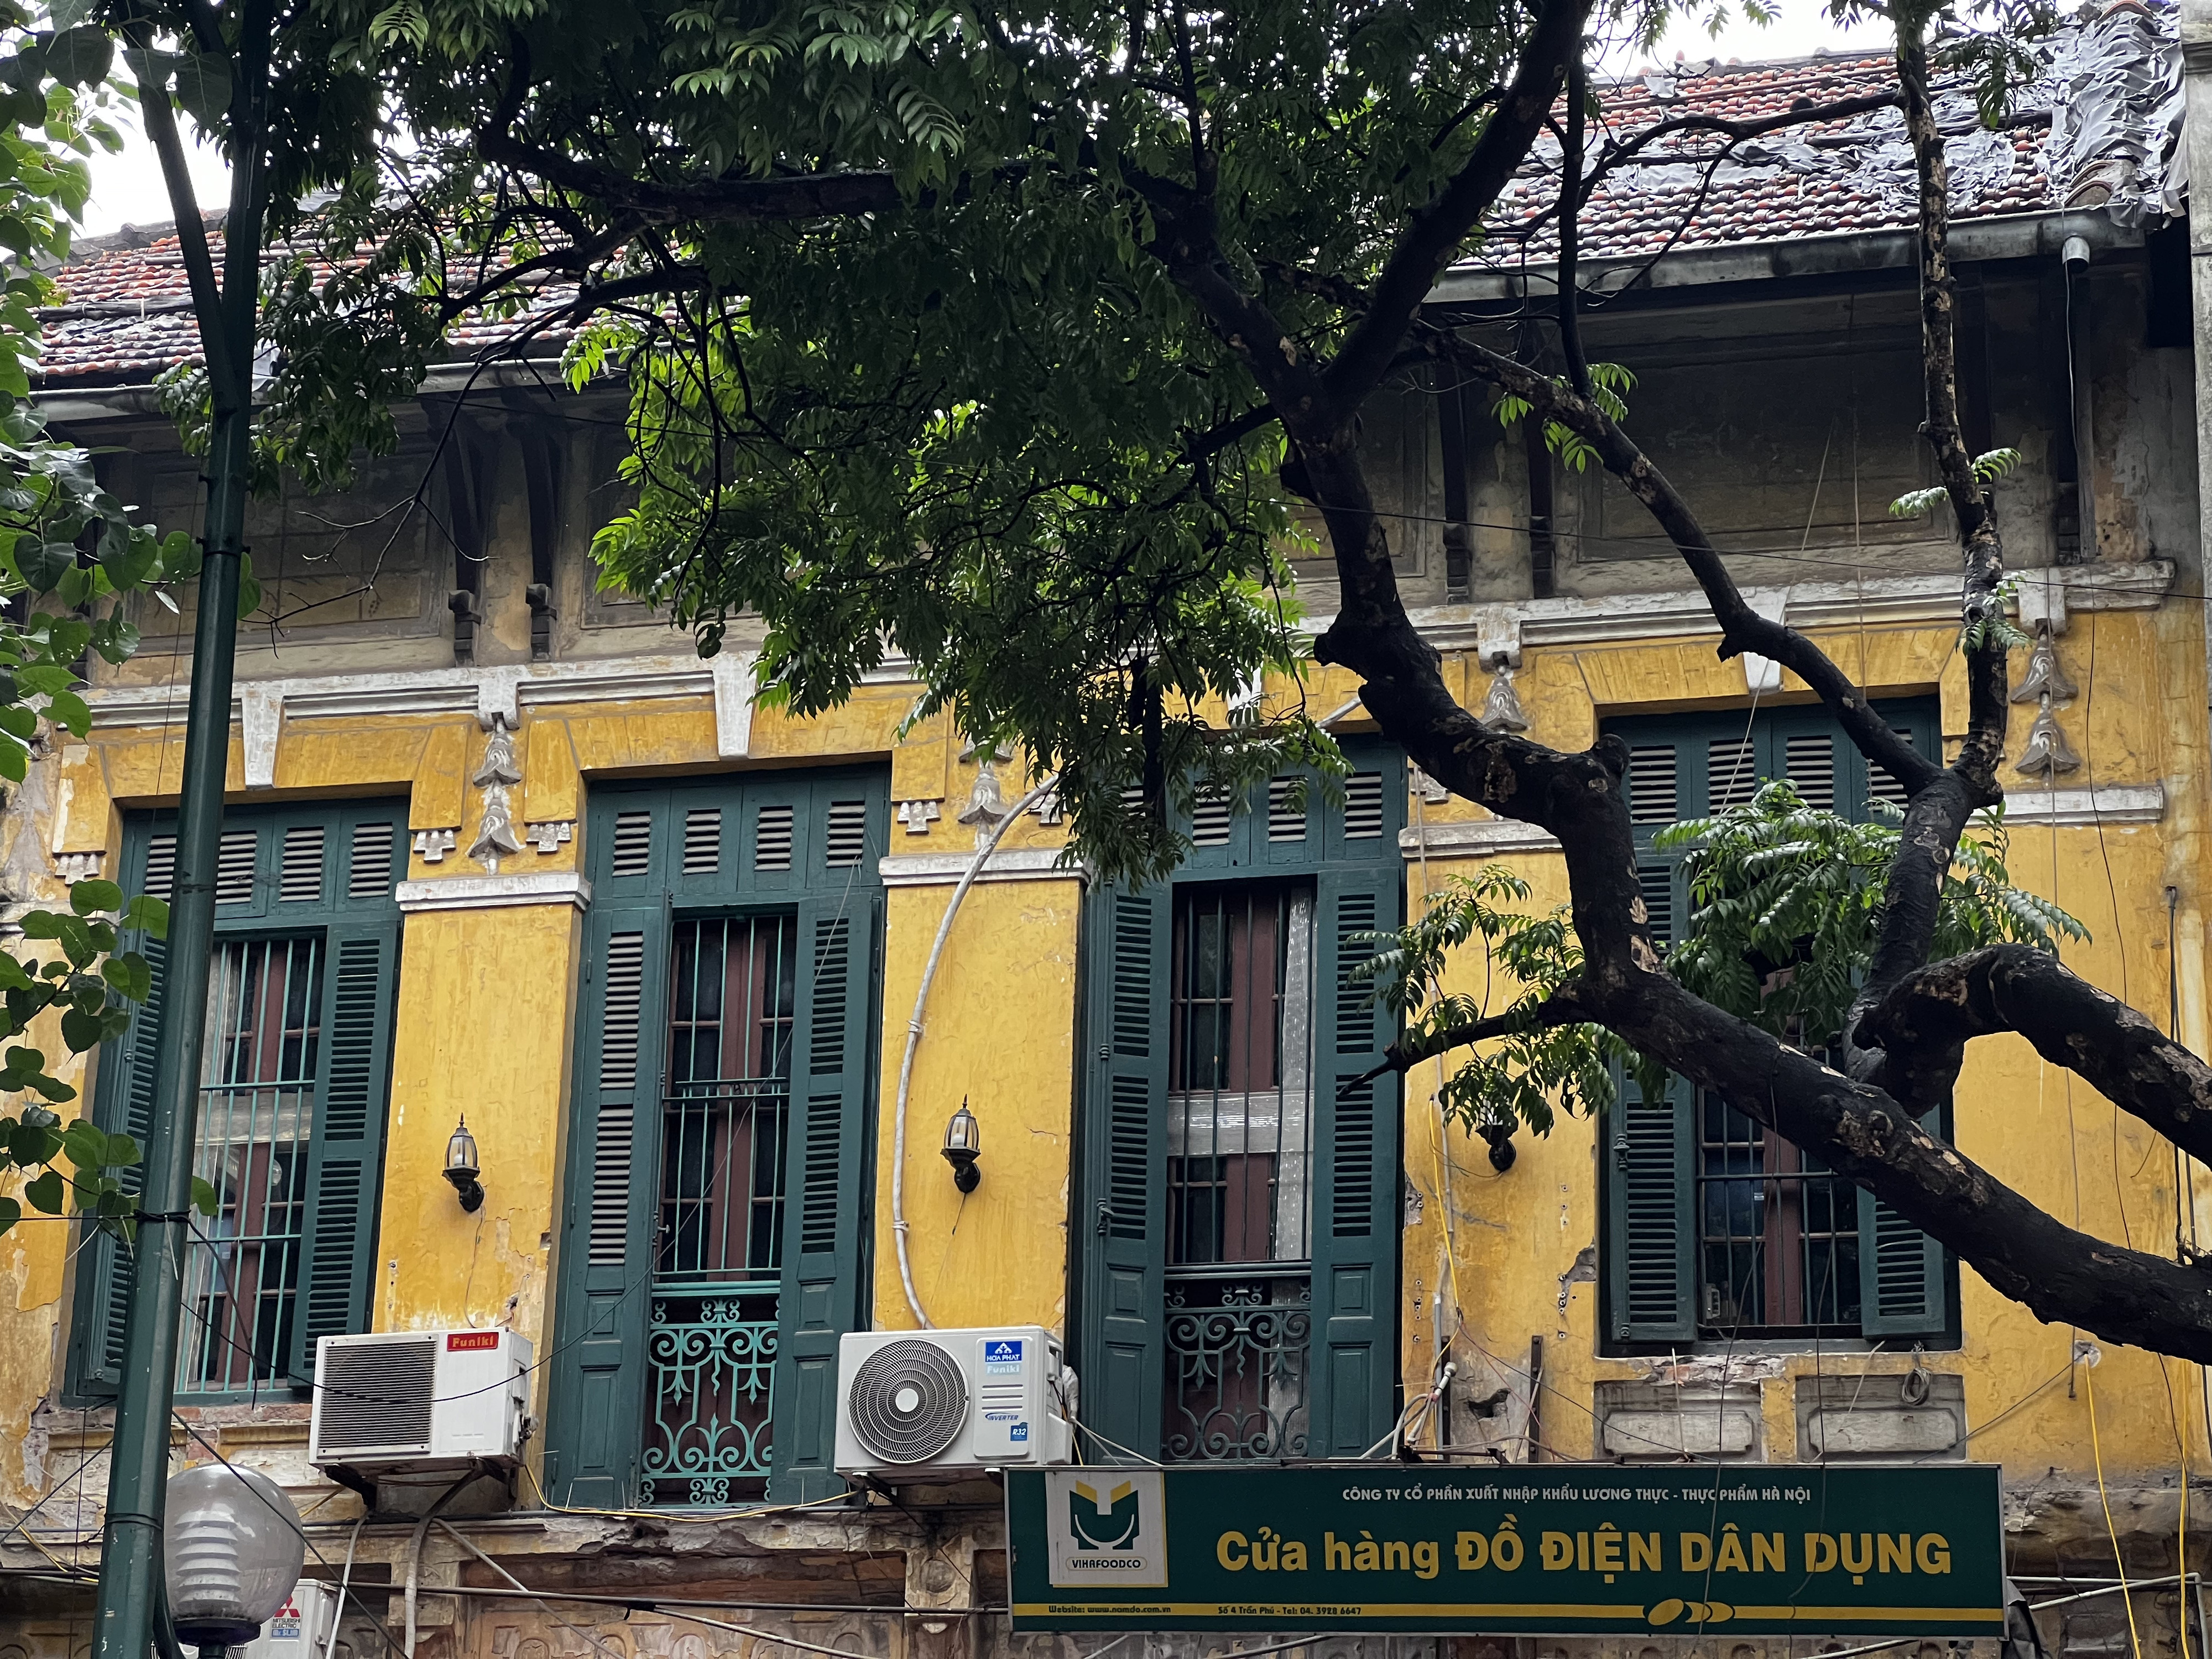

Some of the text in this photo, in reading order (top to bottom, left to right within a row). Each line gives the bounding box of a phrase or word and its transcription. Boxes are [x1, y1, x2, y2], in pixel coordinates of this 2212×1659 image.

[452, 1335, 494, 1348] Funiki
[987, 1365, 1020, 1374] Funiki
[1342, 1486, 1381, 1500] CÔNG
[1385, 1489, 1400, 1500] TY
[1404, 1483, 1423, 1500] CỔ
[1427, 1484, 1462, 1500] PHẦN
[1465, 1484, 1499, 1500] XUẤT
[1503, 1486, 1538, 1504] NHẬP
[1542, 1483, 1579, 1500] KHẨU
[1582, 1488, 1632, 1501] LƯƠNG
[1635, 1488, 1669, 1504] THỰC
[1682, 1488, 1716, 1504] THỰC
[1719, 1484, 1758, 1501] PHẨM
[1762, 1486, 1780, 1501] HÀ
[1785, 1486, 1811, 1504] NỘI
[1217, 1514, 1951, 1585] Cửa hàng ĐỒ ĐIỆN DÂN DỤNG
[1072, 1559, 1141, 1568] VIHAFOODCO
[1218, 1605, 1230, 1614] Số
[1260, 1606, 1274, 1614] Phú
